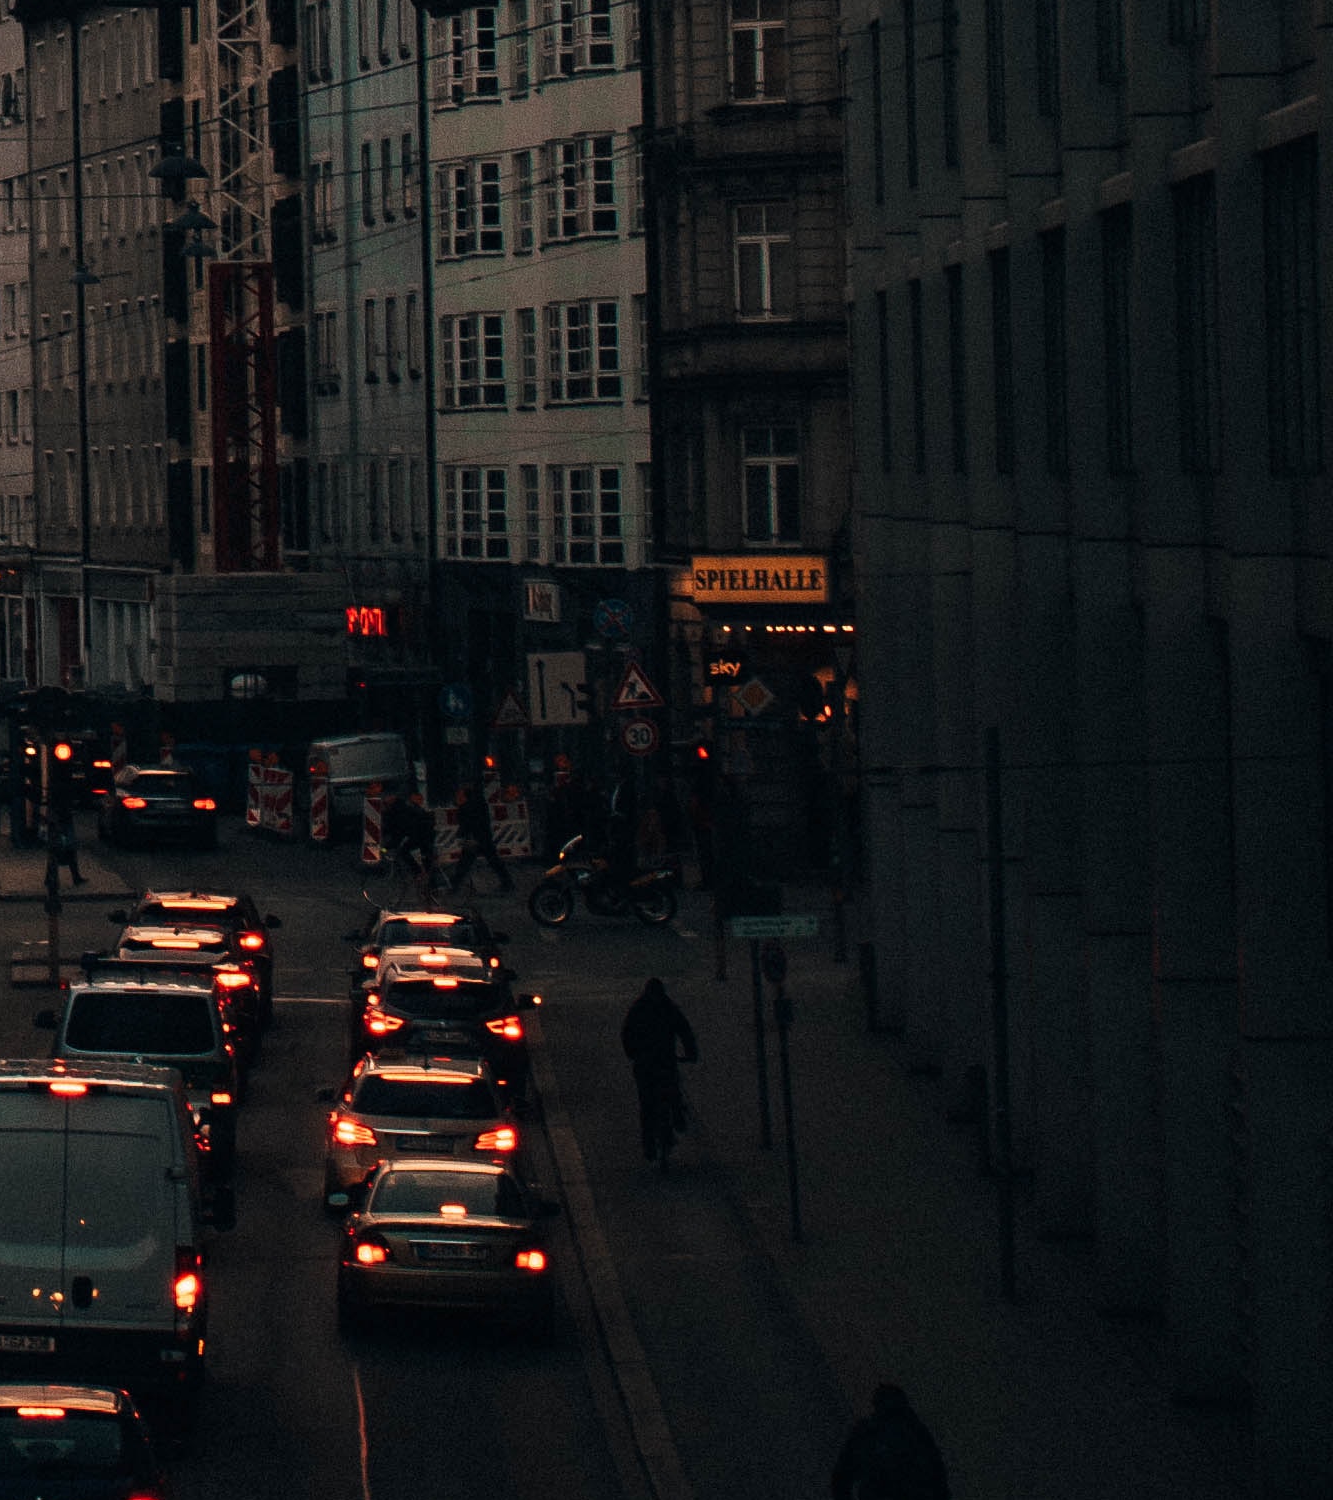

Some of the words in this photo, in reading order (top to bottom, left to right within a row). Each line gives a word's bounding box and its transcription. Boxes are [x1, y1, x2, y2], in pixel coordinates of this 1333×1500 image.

[695, 569, 822, 591] SPIELHALLE
[709, 658, 742, 678] sky
[629, 728, 650, 744] 30
